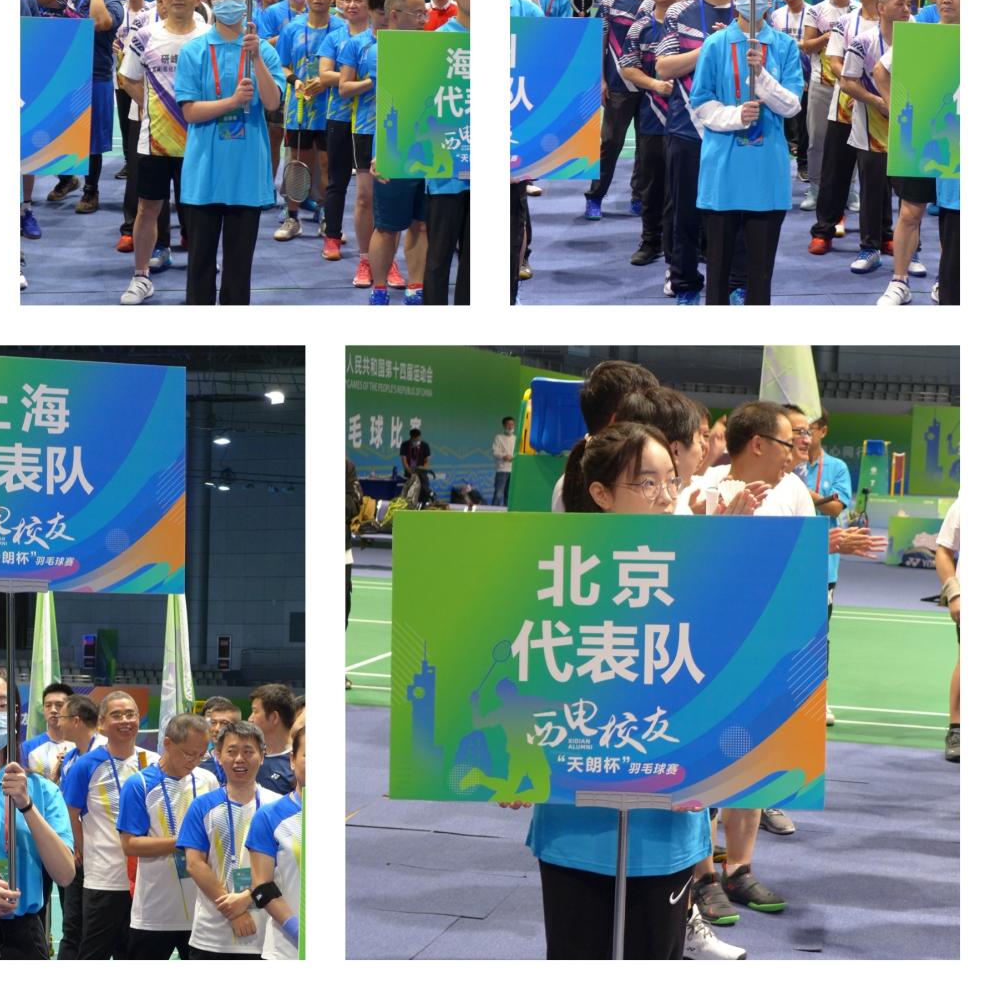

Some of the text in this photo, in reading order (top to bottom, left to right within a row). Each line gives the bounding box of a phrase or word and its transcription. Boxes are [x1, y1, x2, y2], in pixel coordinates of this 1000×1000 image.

[434, 86, 470, 117] 代
[537, 544, 676, 609] 北京
[510, 619, 706, 685] 代表队
[526, 698, 680, 755] 西电校友
[557, 755, 680, 775] “天朗杯”羽毛球赛
